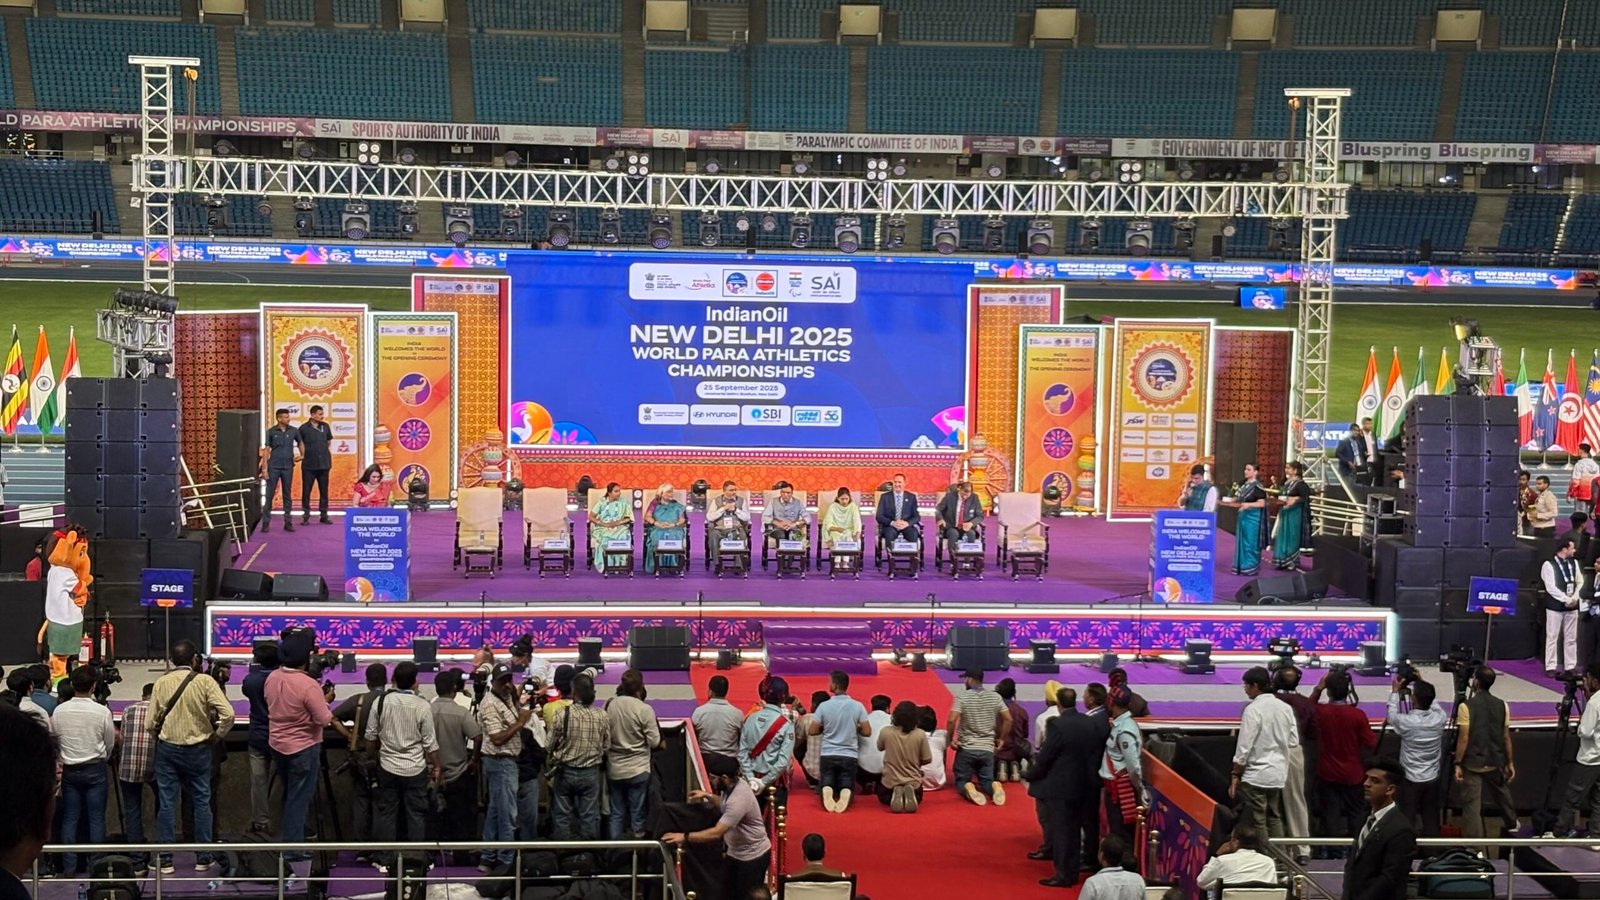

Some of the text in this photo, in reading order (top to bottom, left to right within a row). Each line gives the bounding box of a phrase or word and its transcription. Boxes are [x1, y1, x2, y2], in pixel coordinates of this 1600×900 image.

[22, 114, 66, 127] PARA
[352, 122, 500, 141] SPORTS AUTHORITY OF INDIA
[661, 131, 680, 143] SAI
[797, 135, 855, 148] PARALYMPIC
[857, 137, 911, 149] COMMITTEE
[914, 138, 927, 150] OF
[930, 138, 958, 150] INDIA
[1162, 140, 1240, 157] GOVERNMENT
[1242, 141, 1255, 157] OF
[1258, 142, 1282, 158] NCT
[1284, 142, 1298, 158] OF
[1341, 142, 1431, 160] Bluspring
[1438, 143, 1530, 161] Bluspring
[811, 276, 841, 290] SAI
[706, 306, 787, 322] IndianOil
[630, 324, 853, 346] NEW DELHI 2025
[632, 346, 851, 362] WORLD PARA ATHLETICS
[667, 364, 815, 379] CHAMPIONSHIPS
[715, 384, 758, 392] September
[763, 408, 781, 419] SBI
[151, 584, 184, 592] STAGE
[1478, 591, 1509, 601] STAGE
